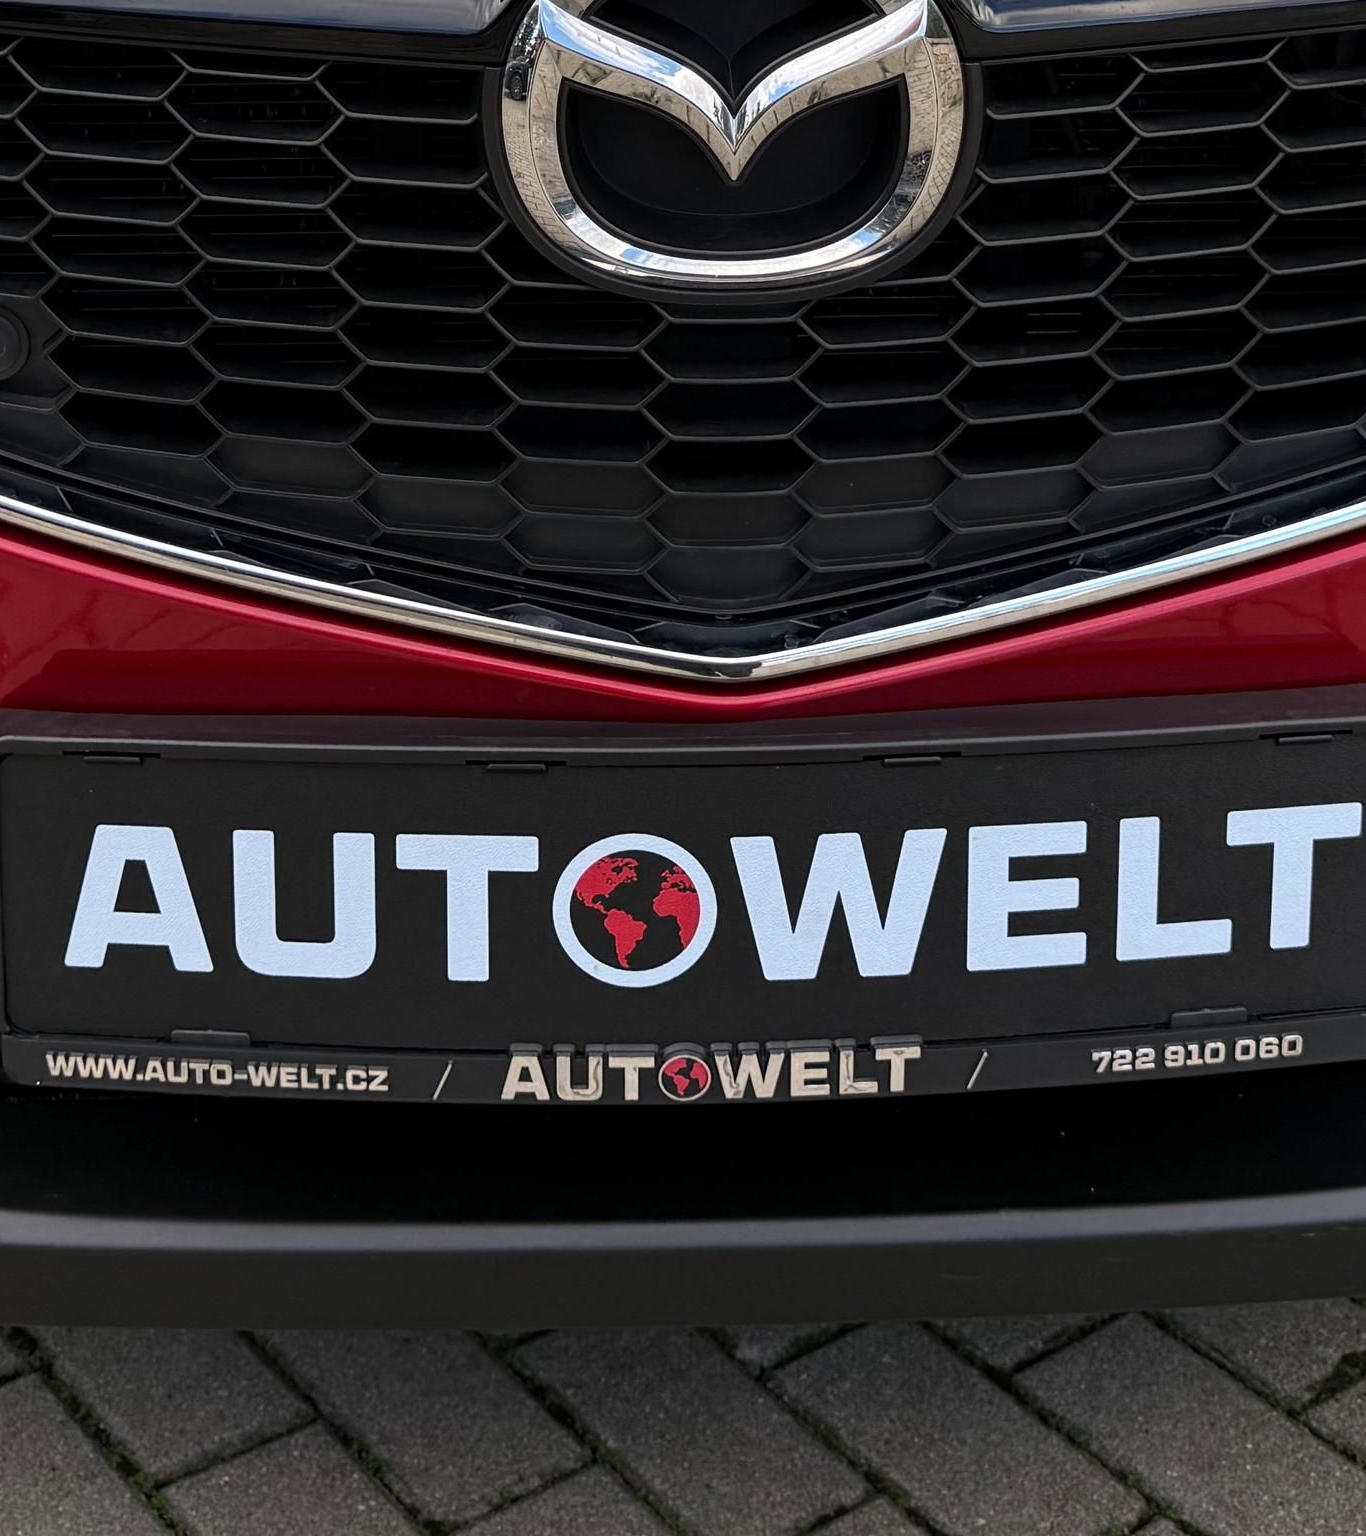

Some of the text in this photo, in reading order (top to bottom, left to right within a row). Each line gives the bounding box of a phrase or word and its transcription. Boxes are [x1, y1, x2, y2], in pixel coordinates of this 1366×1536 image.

[64, 802, 1363, 988] AUTOWELT
[45, 1051, 389, 1092] WWW.AUTO-WELT.CZ
[501, 1036, 925, 1101] AUTOWELT
[1091, 1048, 1156, 1073] 722
[1164, 1038, 1226, 1068] 910
[1235, 1033, 1303, 1062] 060
